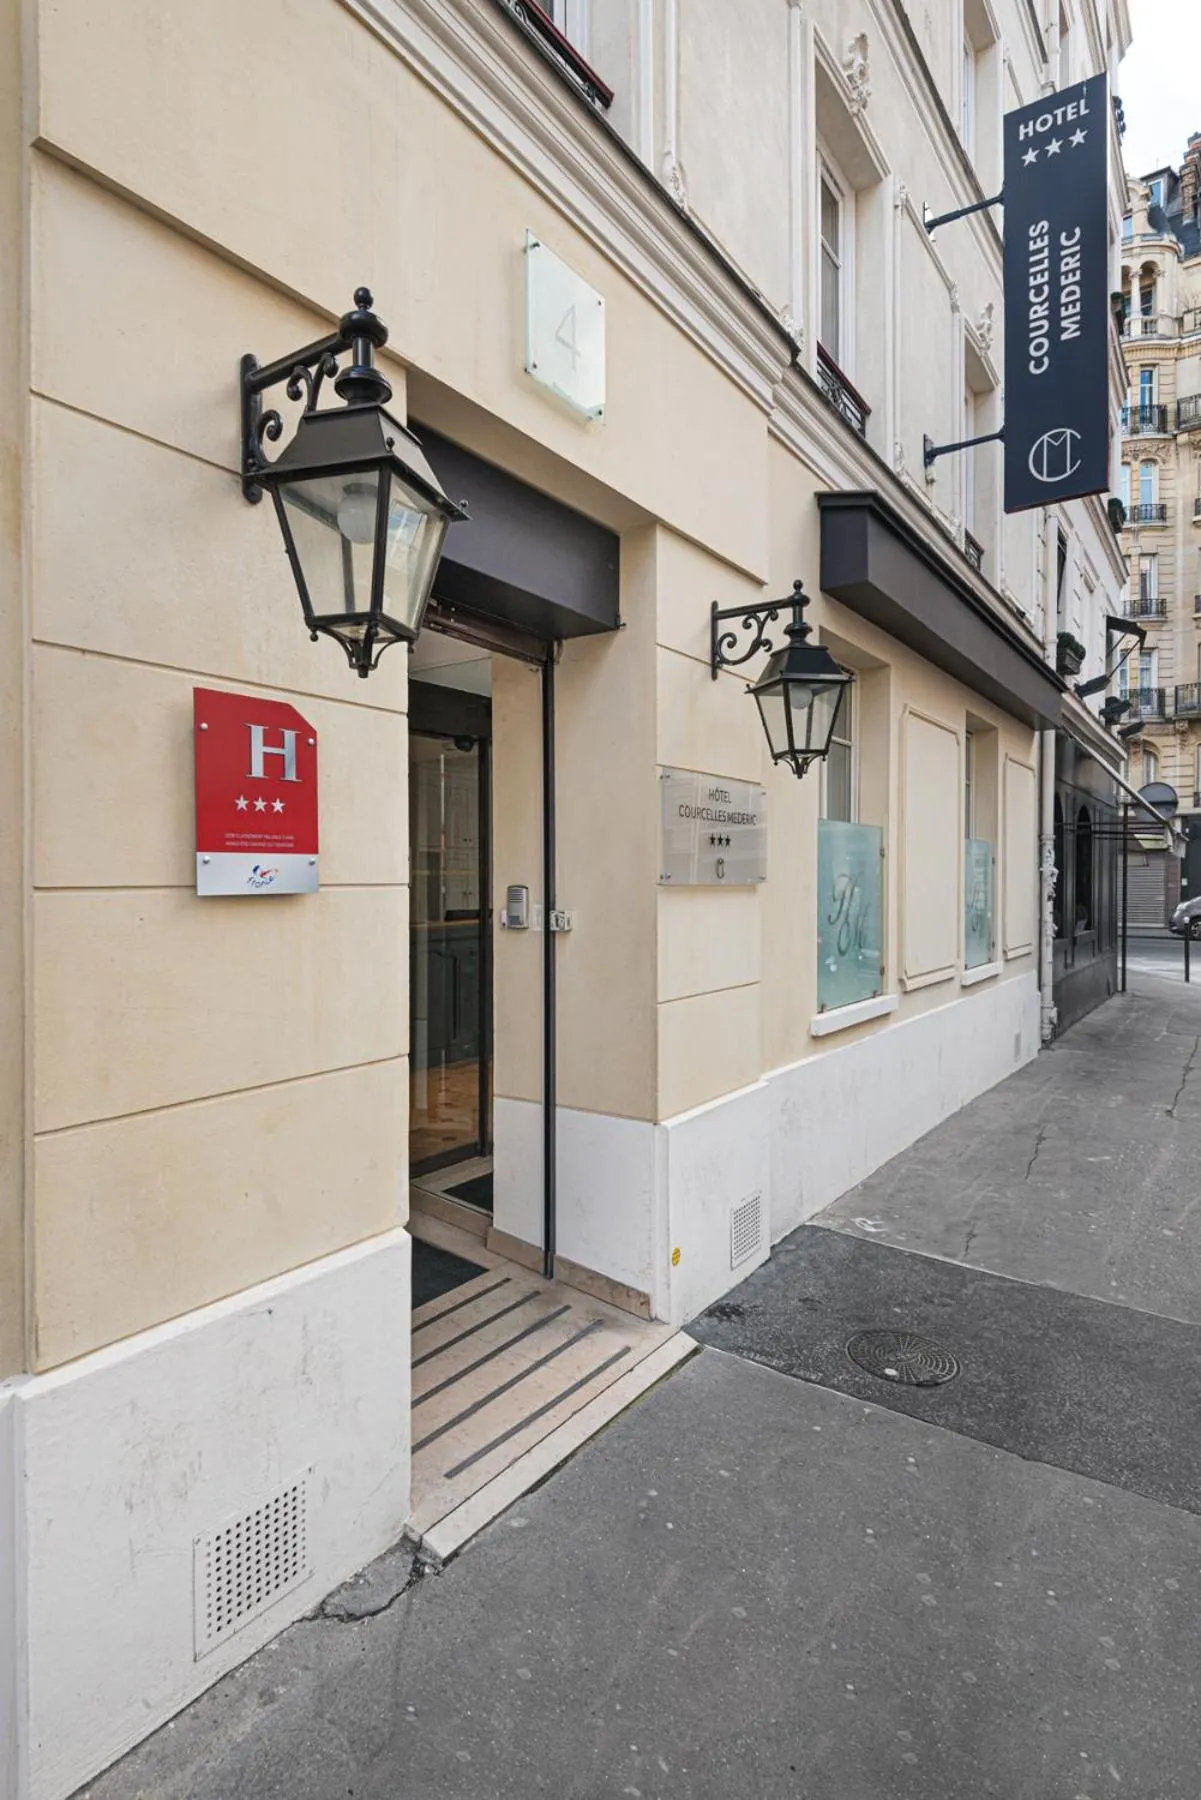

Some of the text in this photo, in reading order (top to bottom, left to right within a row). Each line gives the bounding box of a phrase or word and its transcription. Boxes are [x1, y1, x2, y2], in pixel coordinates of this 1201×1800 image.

[1018, 98, 1089, 141] HOTEL
[1029, 219, 1049, 376] COURCELLES
[1060, 226, 1082, 341] MEDERIC
[555, 303, 581, 372] 4
[243, 722, 303, 782] H
[678, 804, 726, 822] COURCELLES
